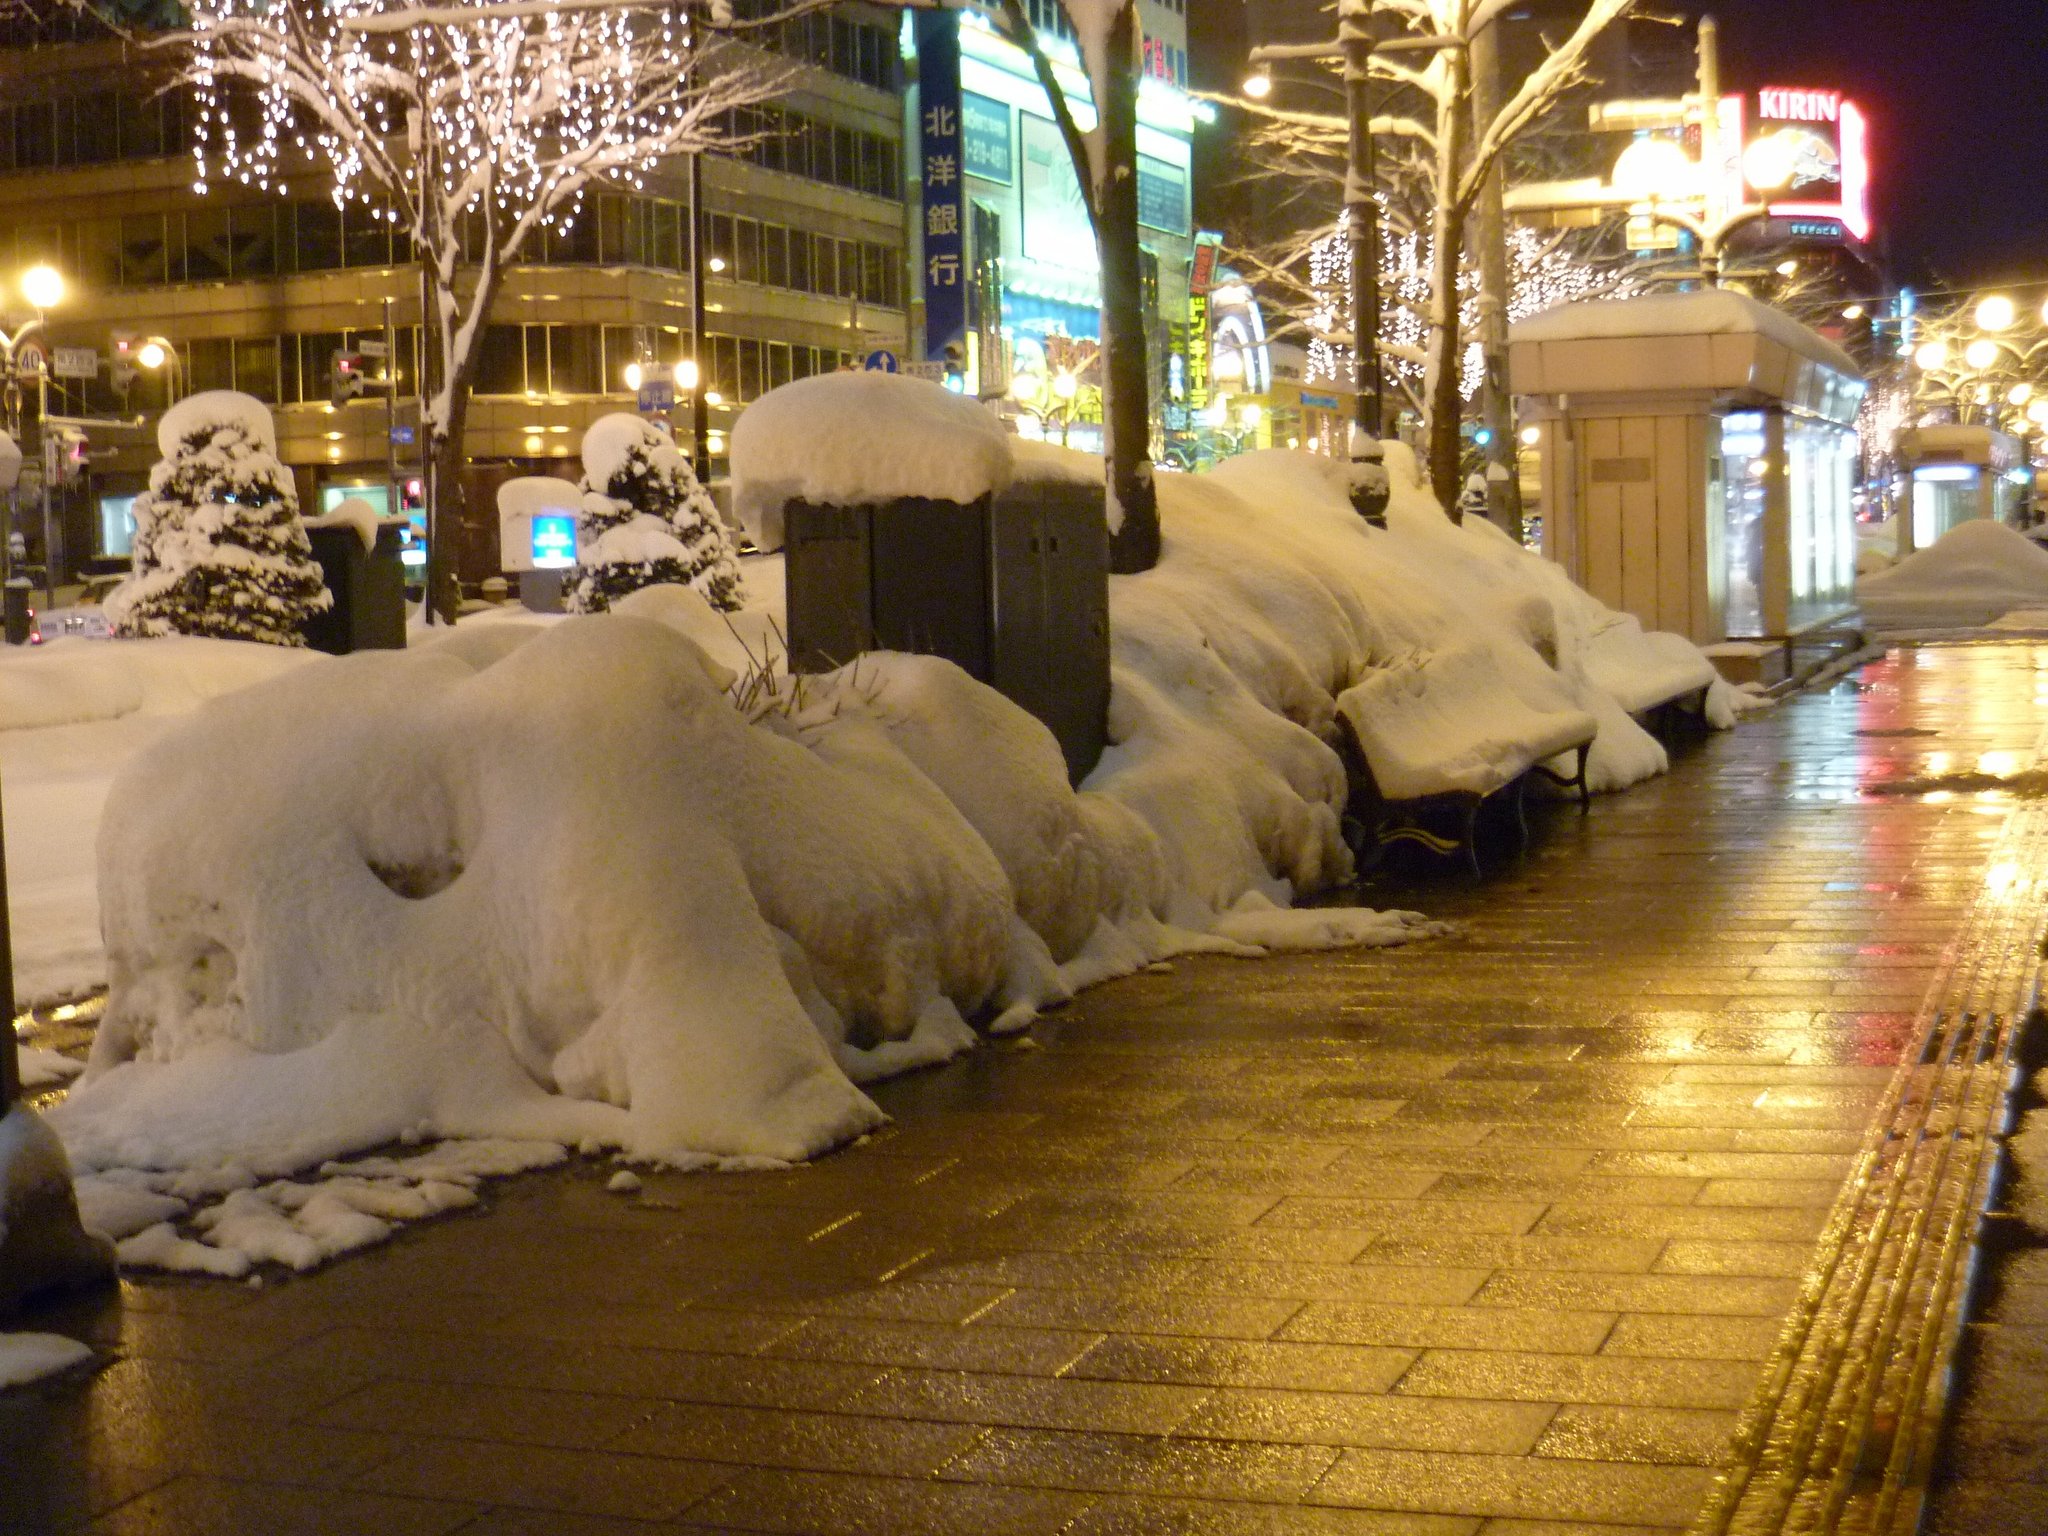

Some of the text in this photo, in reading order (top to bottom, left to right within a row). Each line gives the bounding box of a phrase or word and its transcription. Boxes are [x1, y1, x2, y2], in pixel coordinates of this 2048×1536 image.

[1759, 90, 1836, 121] KIRIN
[925, 105, 959, 287] 北洋銀行
[22, 351, 40, 369] 40
